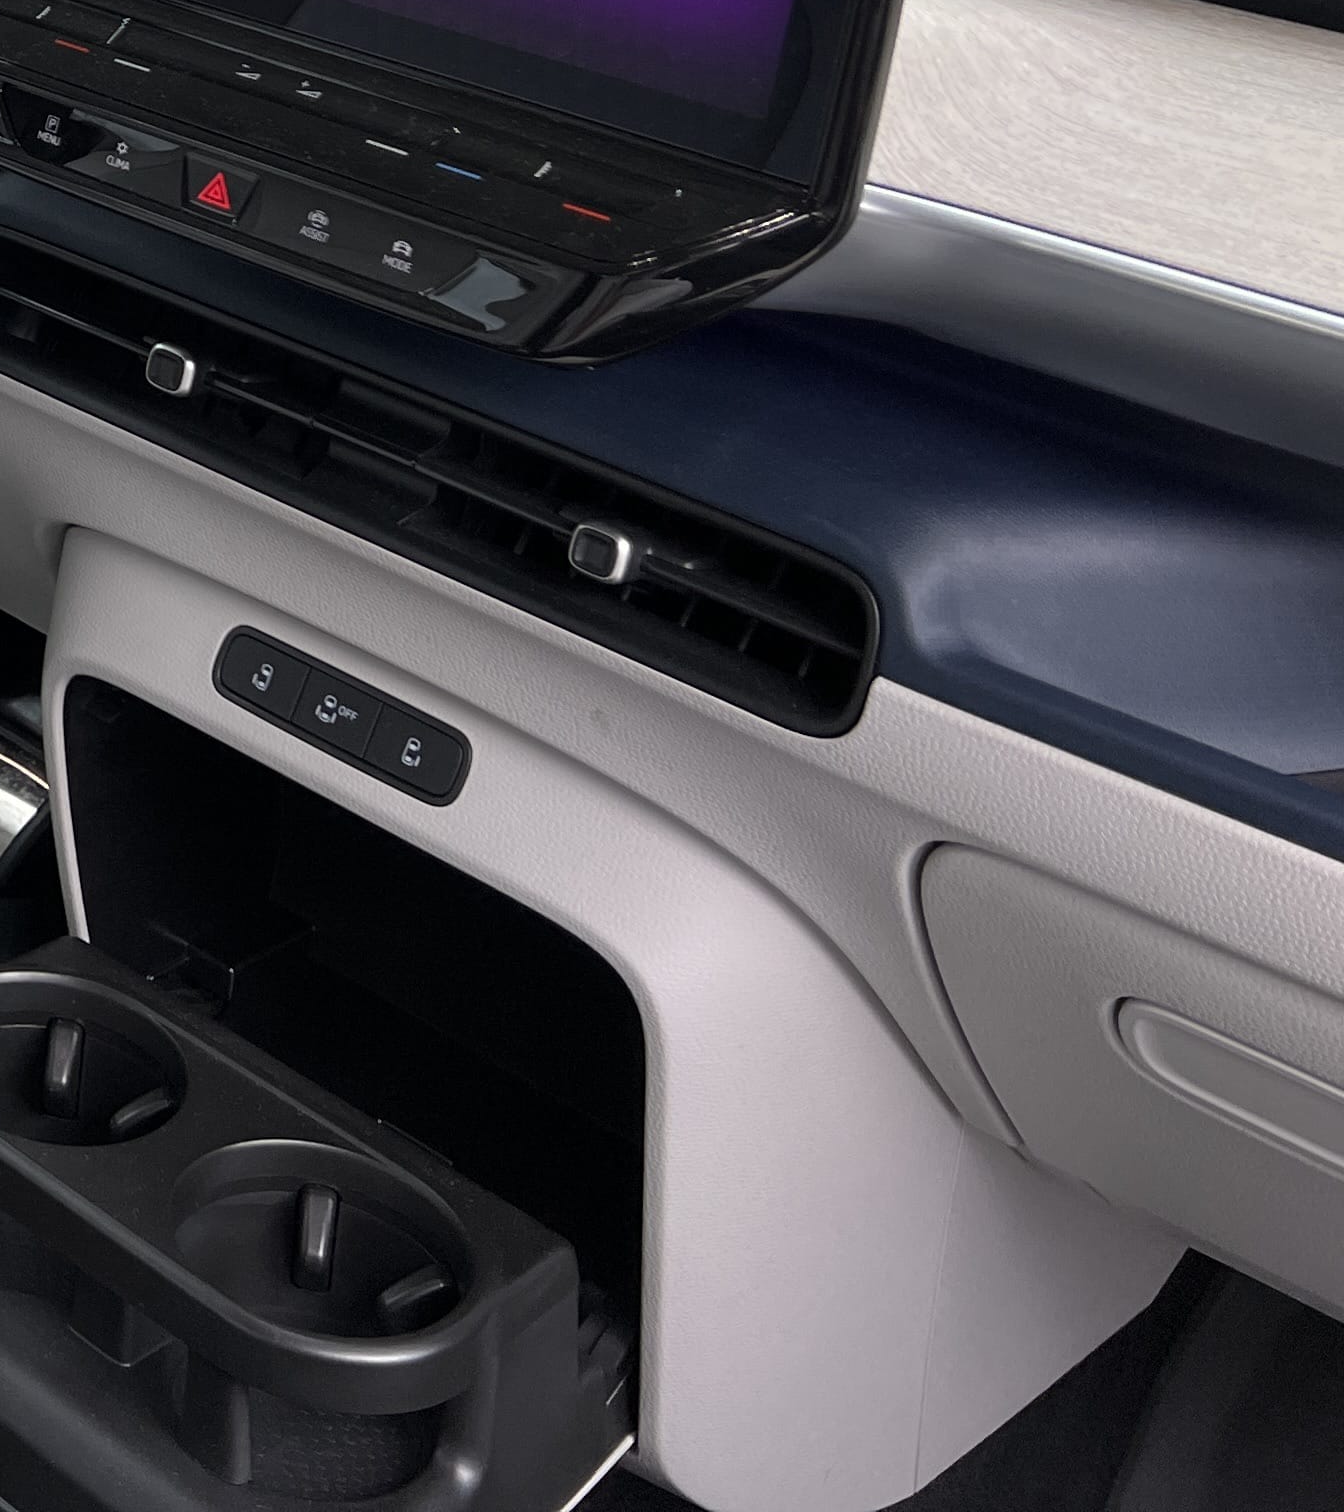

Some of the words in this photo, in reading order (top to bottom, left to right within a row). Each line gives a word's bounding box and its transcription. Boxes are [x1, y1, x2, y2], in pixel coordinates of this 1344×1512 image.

[36, 129, 62, 147] MENU
[105, 154, 131, 172] CLIMA
[381, 253, 414, 275] MODE
[337, 704, 360, 721] OFF
